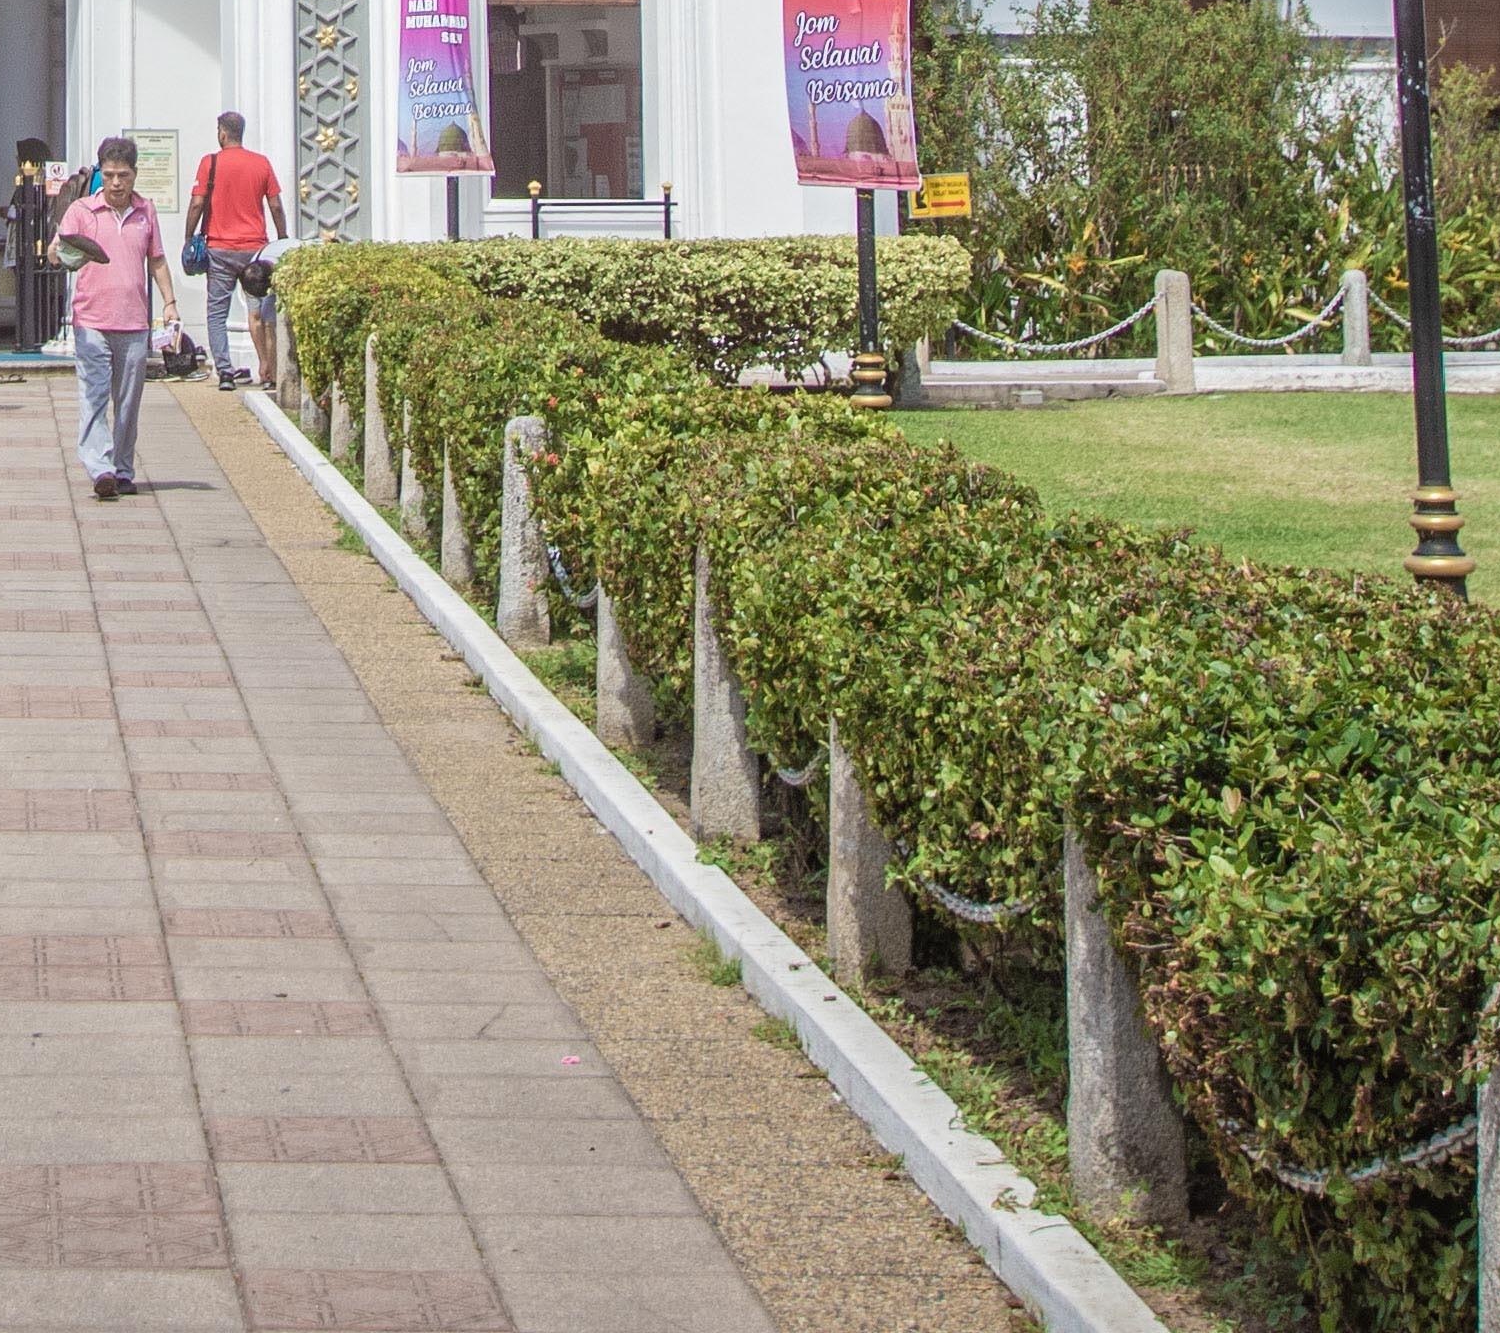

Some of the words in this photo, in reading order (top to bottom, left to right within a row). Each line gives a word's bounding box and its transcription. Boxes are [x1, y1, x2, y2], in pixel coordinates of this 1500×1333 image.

[794, 11, 840, 47] Jom
[406, 57, 438, 82] Jom
[800, 38, 882, 72] Selawat
[806, 77, 898, 105] Bersama
